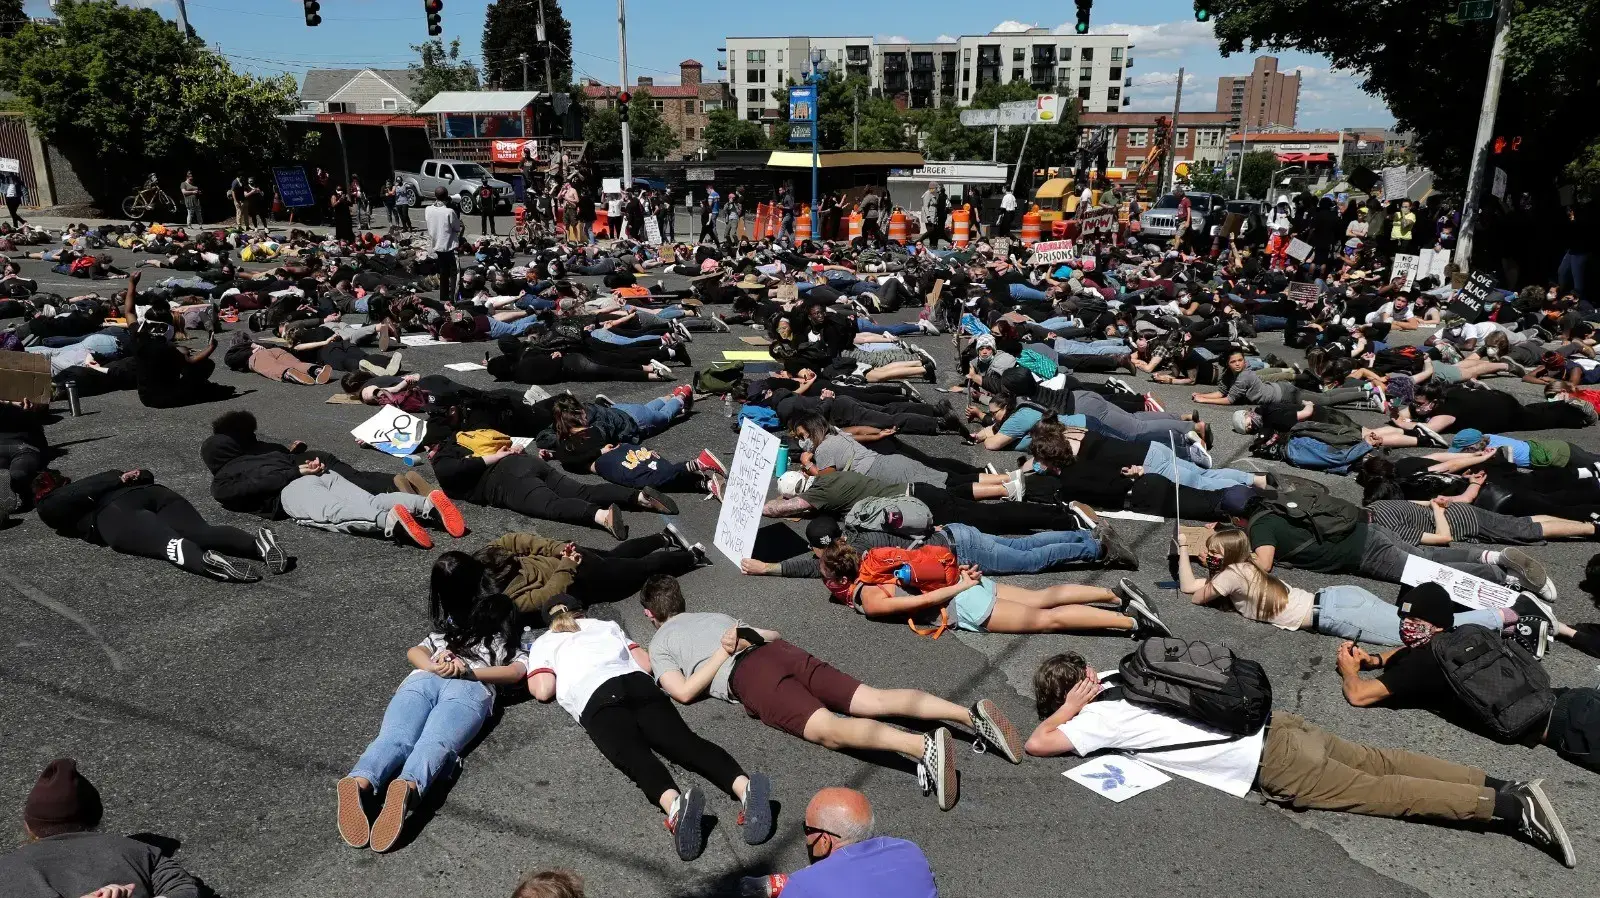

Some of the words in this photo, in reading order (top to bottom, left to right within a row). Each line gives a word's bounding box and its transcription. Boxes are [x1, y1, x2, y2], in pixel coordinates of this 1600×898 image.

[1511, 136, 1522, 151] 12
[1037, 250, 1072, 262] PRISONS
[1394, 261, 1418, 271] JUSTICE
[1471, 270, 1493, 288] LOVE
[1464, 281, 1489, 301] BLACK
[1457, 292, 1482, 312] PEOPLE
[747, 425, 770, 452] THEY
[739, 440, 771, 470] PROTECT
[740, 459, 760, 487] WHITE
[167, 538, 178, 562] NIKE
